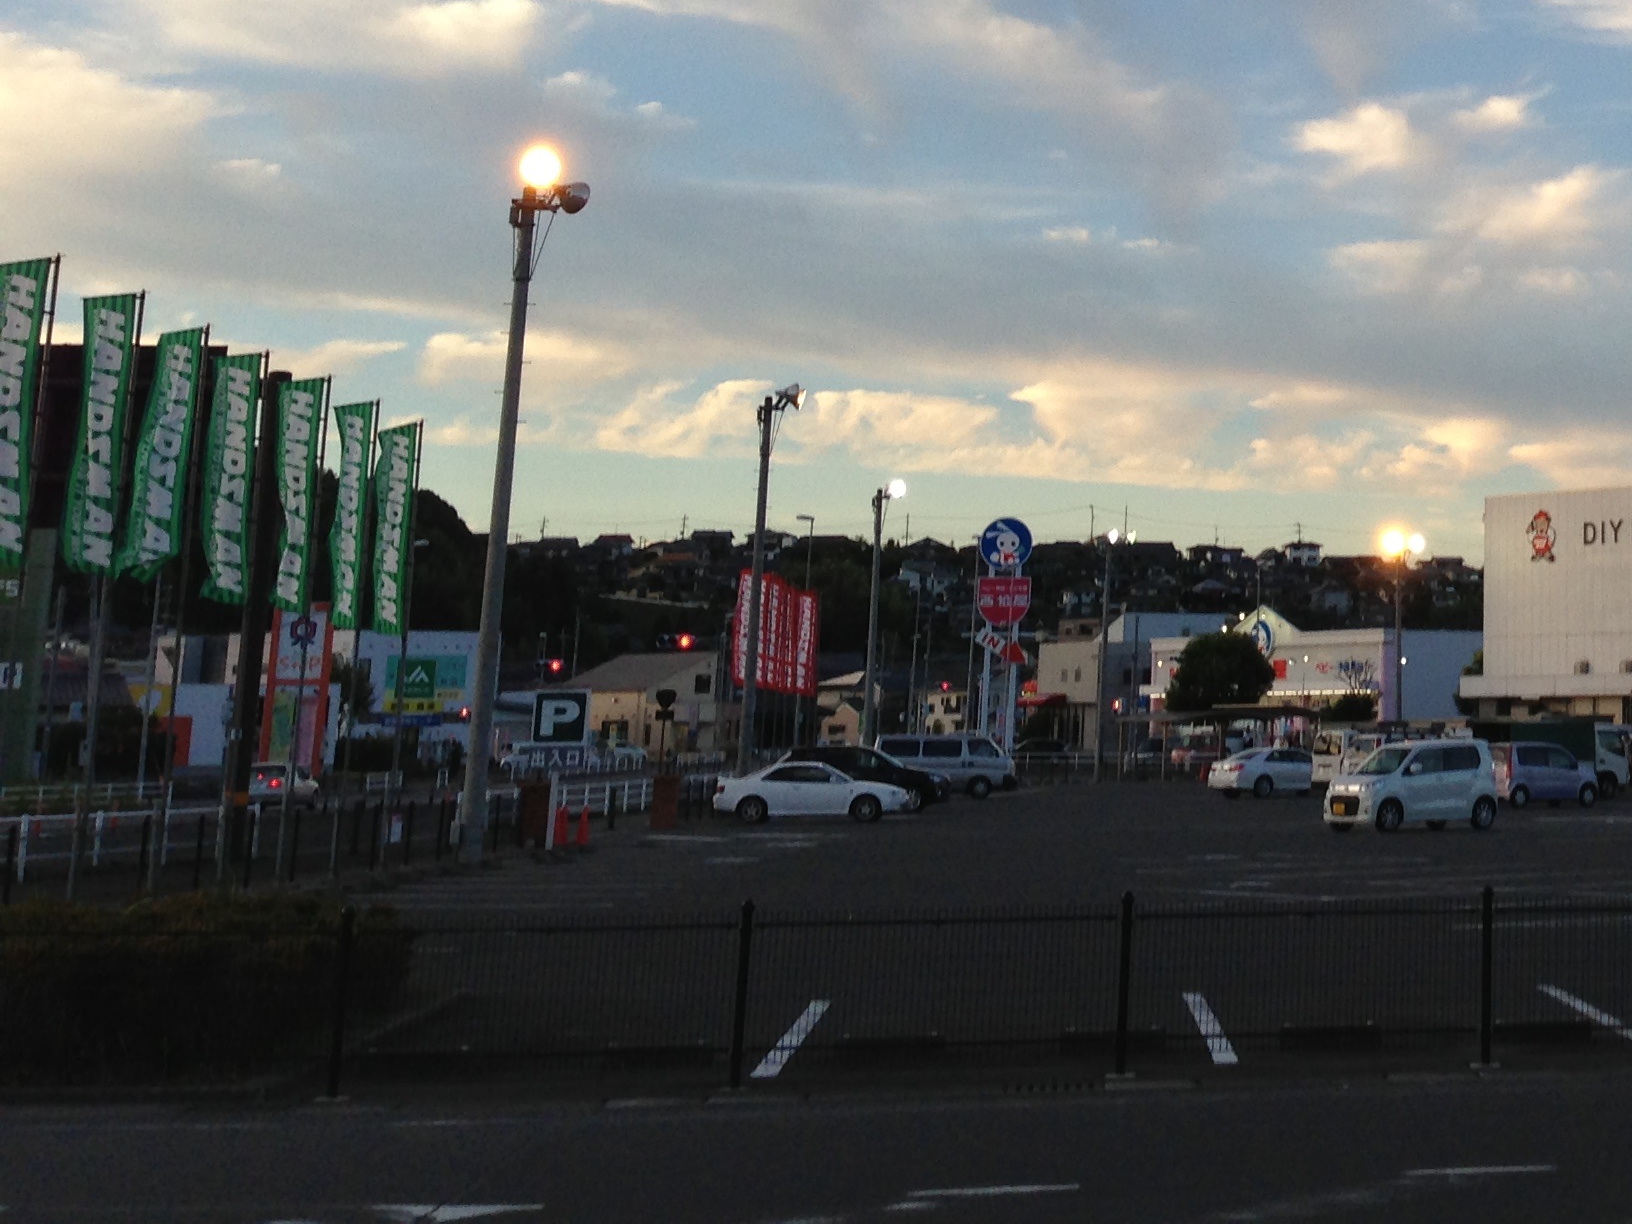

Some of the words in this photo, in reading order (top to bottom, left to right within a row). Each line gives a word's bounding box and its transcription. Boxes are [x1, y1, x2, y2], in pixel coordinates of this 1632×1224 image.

[82, 308, 125, 567] HANDSMAN
[212, 367, 251, 593] HANDSMAN
[277, 389, 314, 603] HANDSMAN
[337, 414, 365, 617] HANDSMAN
[380, 433, 409, 624] HANDSMAN
[1583, 520, 1623, 545] DIY
[540, 699, 580, 736] P
[982, 633, 999, 649] IN
